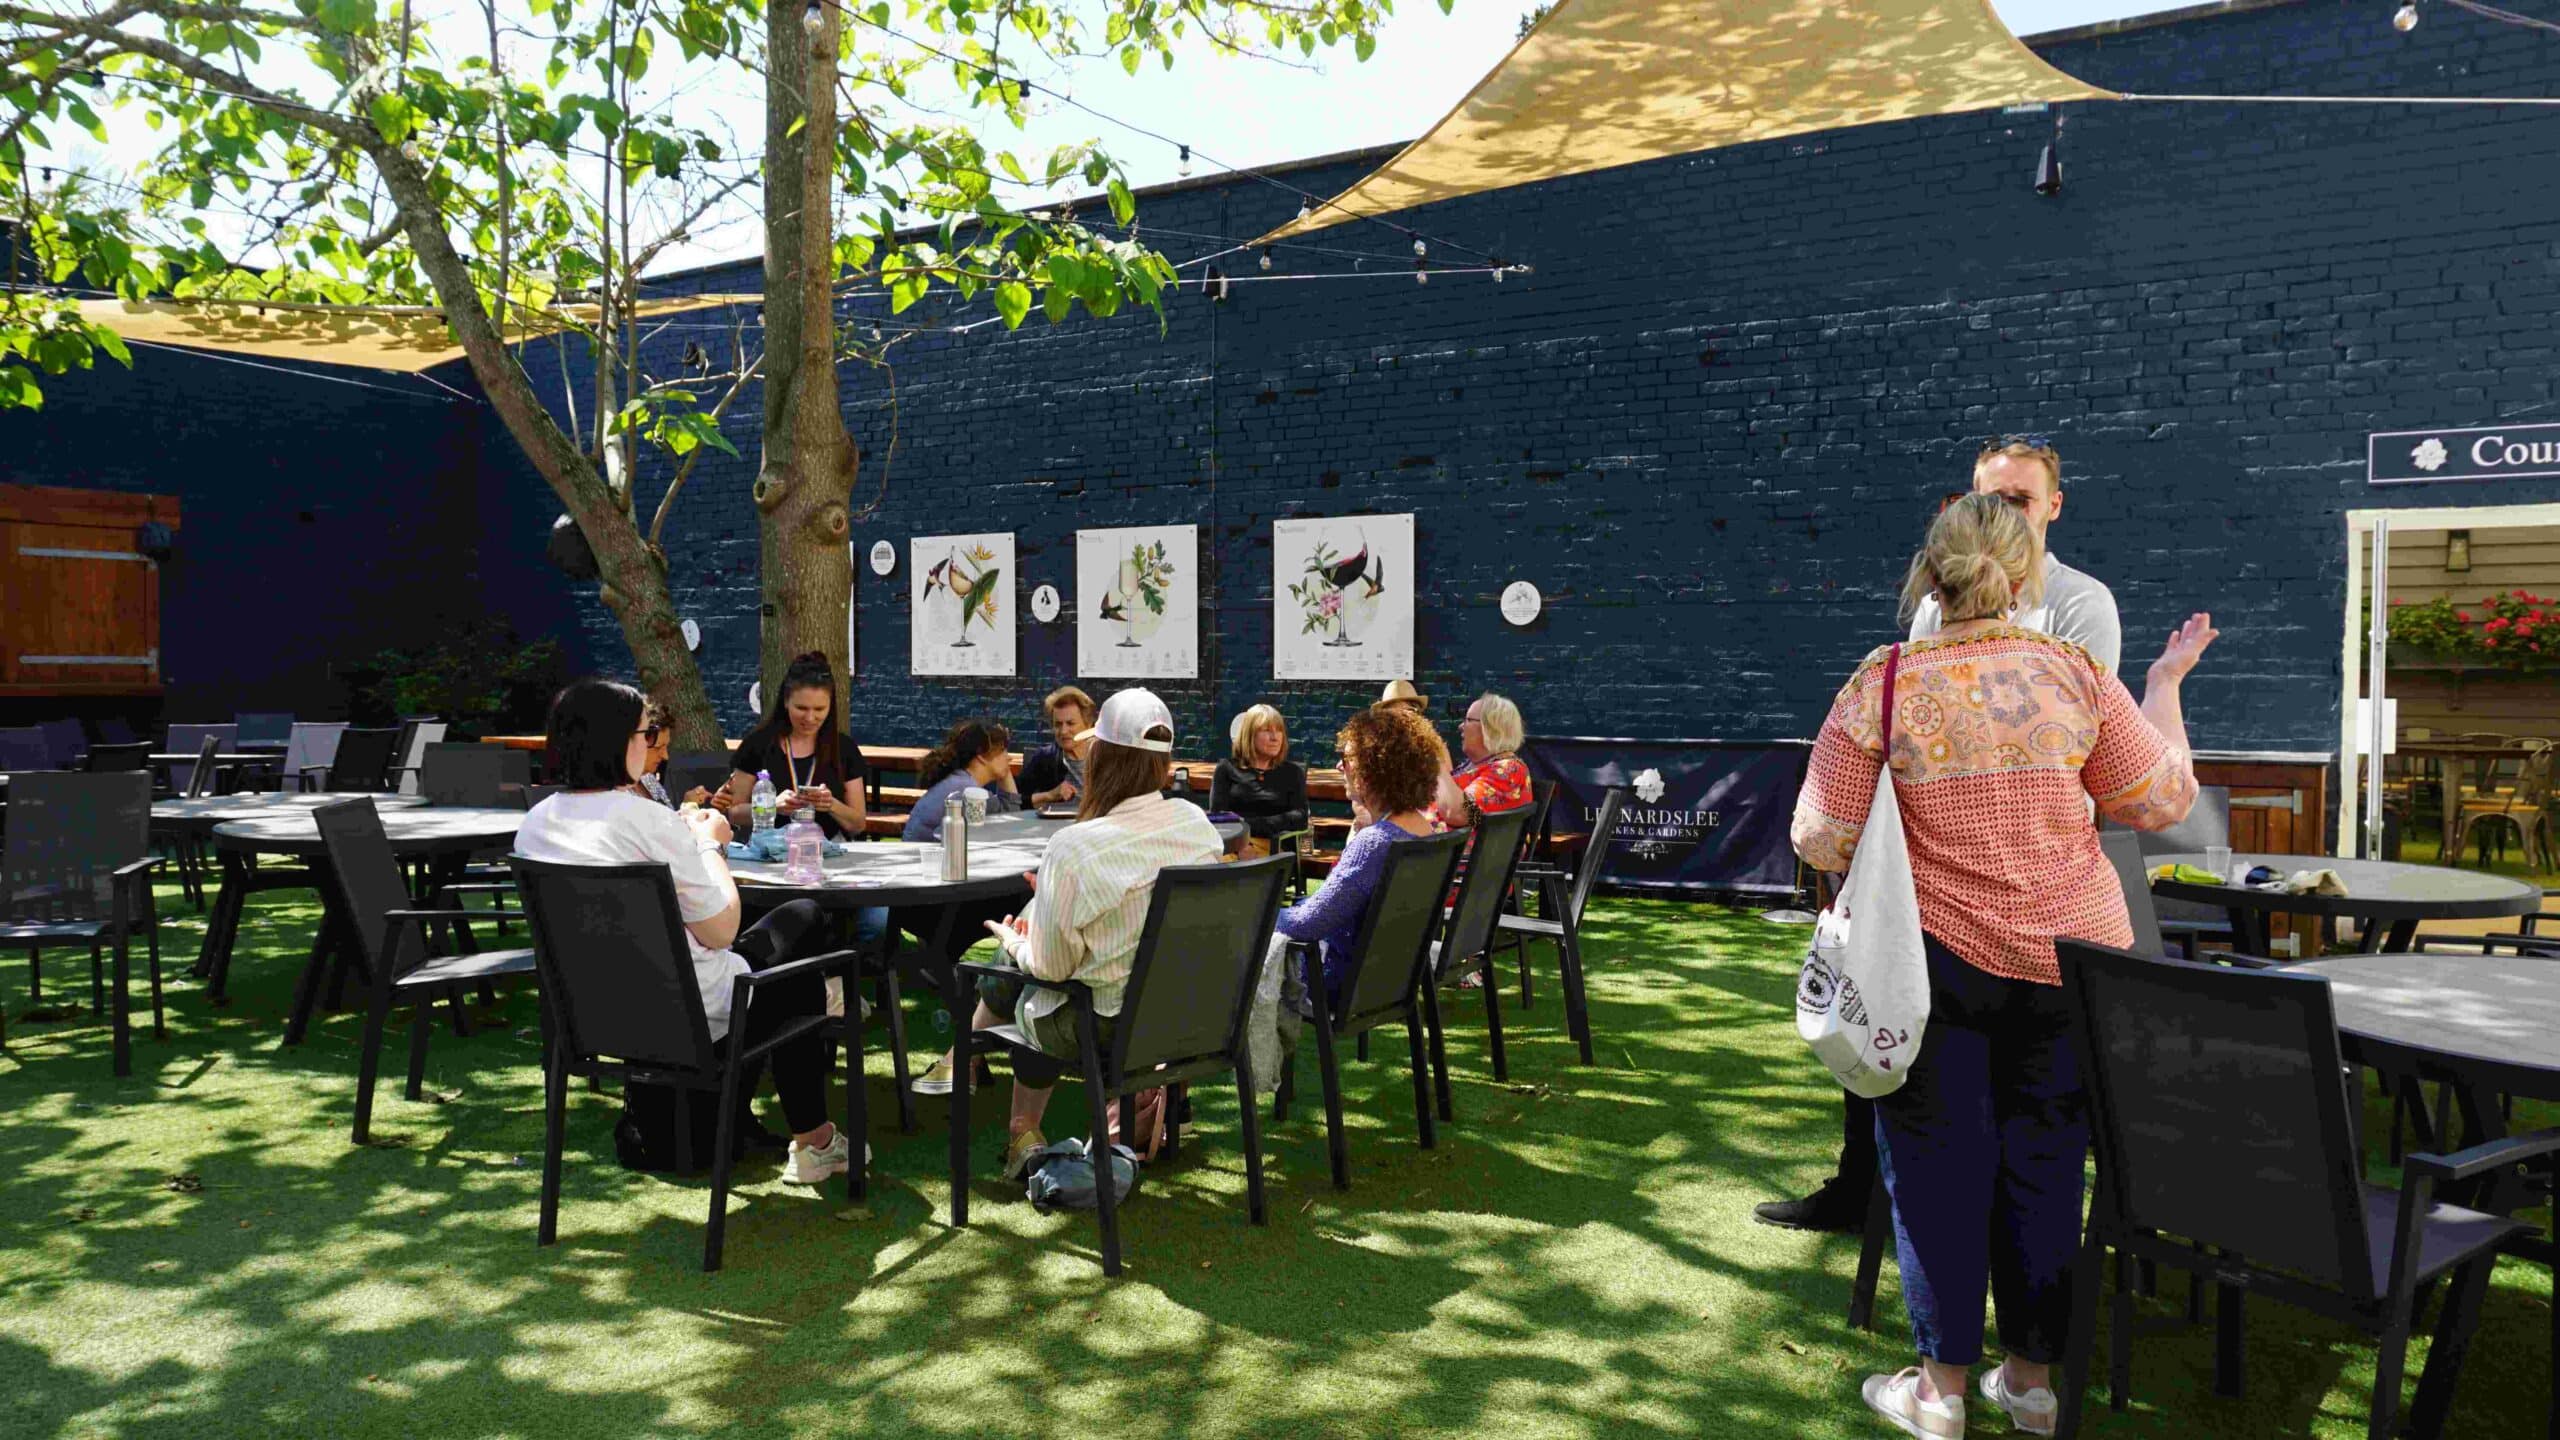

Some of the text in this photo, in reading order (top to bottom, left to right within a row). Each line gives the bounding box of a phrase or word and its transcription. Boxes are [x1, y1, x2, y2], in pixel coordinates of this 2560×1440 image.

[2471, 435, 2560, 467] Cou
[1584, 806, 1720, 827] LNARDSLEE
[1638, 826, 1645, 836] &
[1648, 827, 1700, 838] GARDENS
